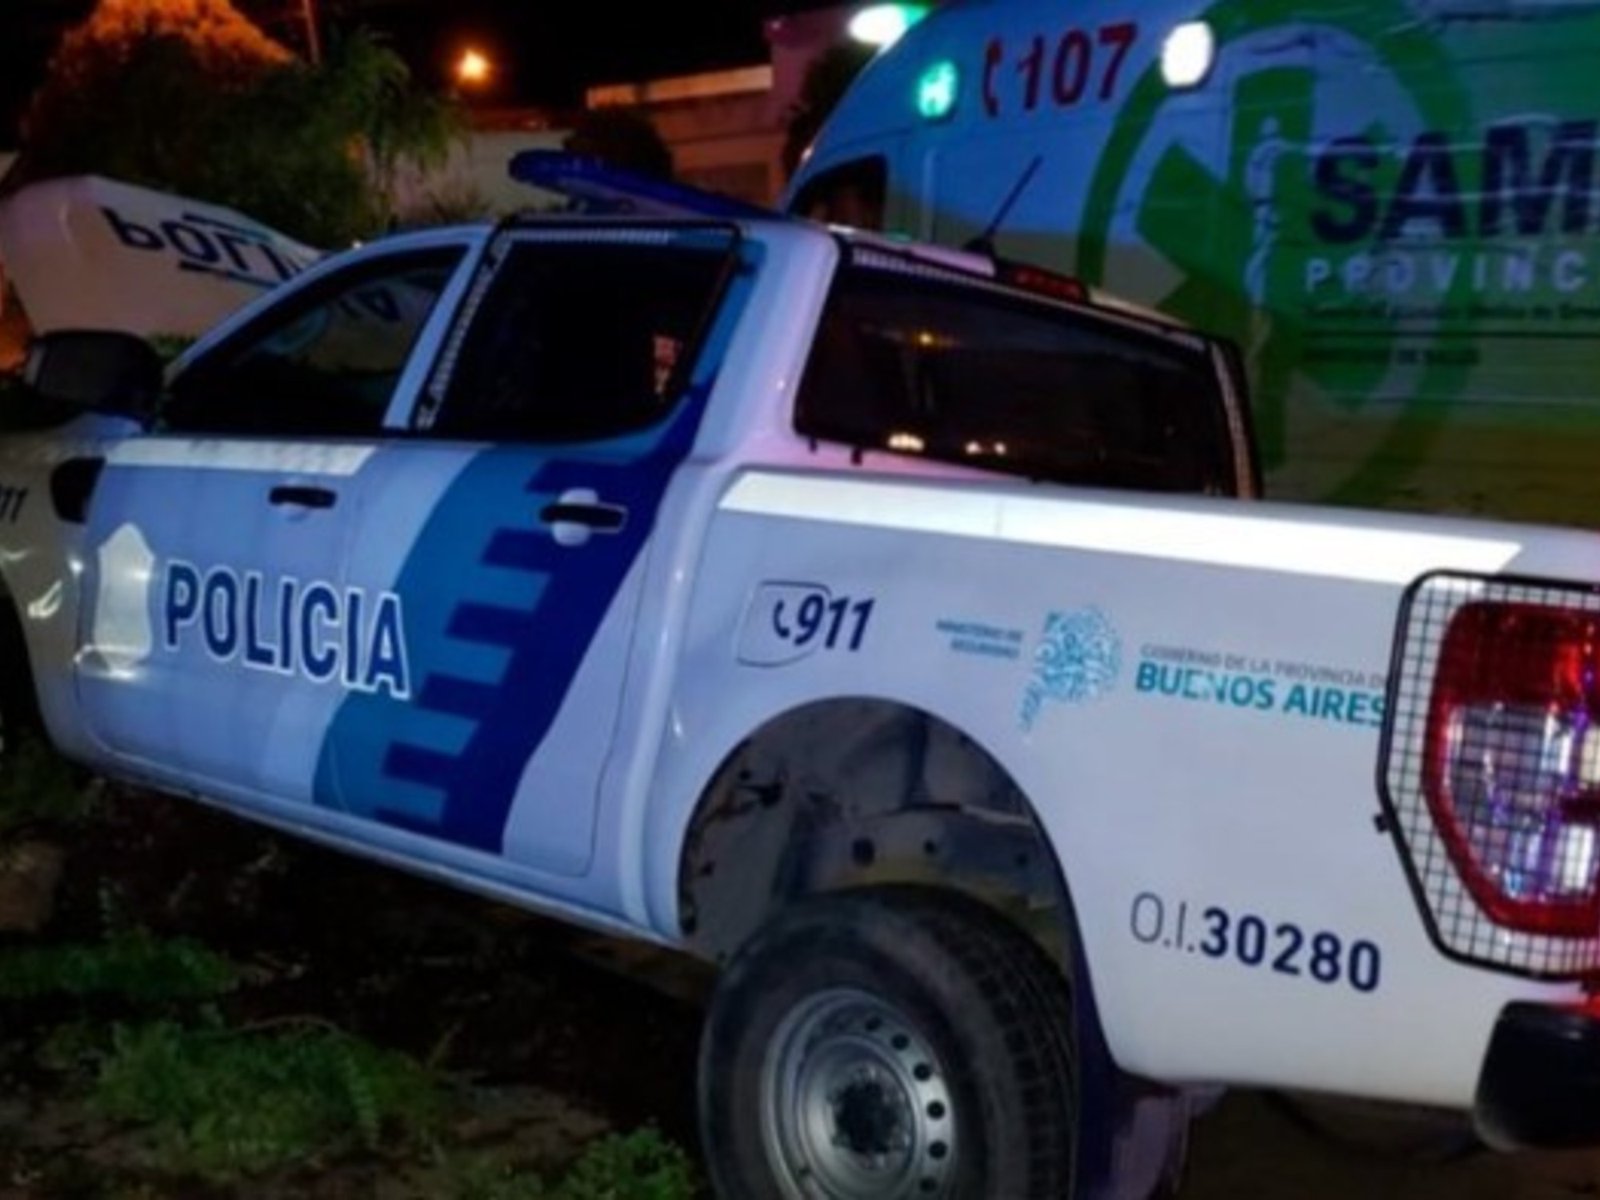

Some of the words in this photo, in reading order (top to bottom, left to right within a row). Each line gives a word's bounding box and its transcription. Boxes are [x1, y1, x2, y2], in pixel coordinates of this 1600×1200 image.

[1016, 22, 1138, 111] 107
[1308, 119, 1598, 244] SAM
[1305, 249, 1588, 295] PROVINC
[0, 486, 28, 526] 11
[164, 559, 411, 699] POLICIA
[794, 592, 876, 652] 911
[1135, 660, 1277, 711] BUENOS
[1282, 682, 1387, 727] AIRES
[1224, 653, 1246, 671] DE
[1249, 658, 1272, 674] LA
[1275, 660, 1365, 686] PROVINCIA
